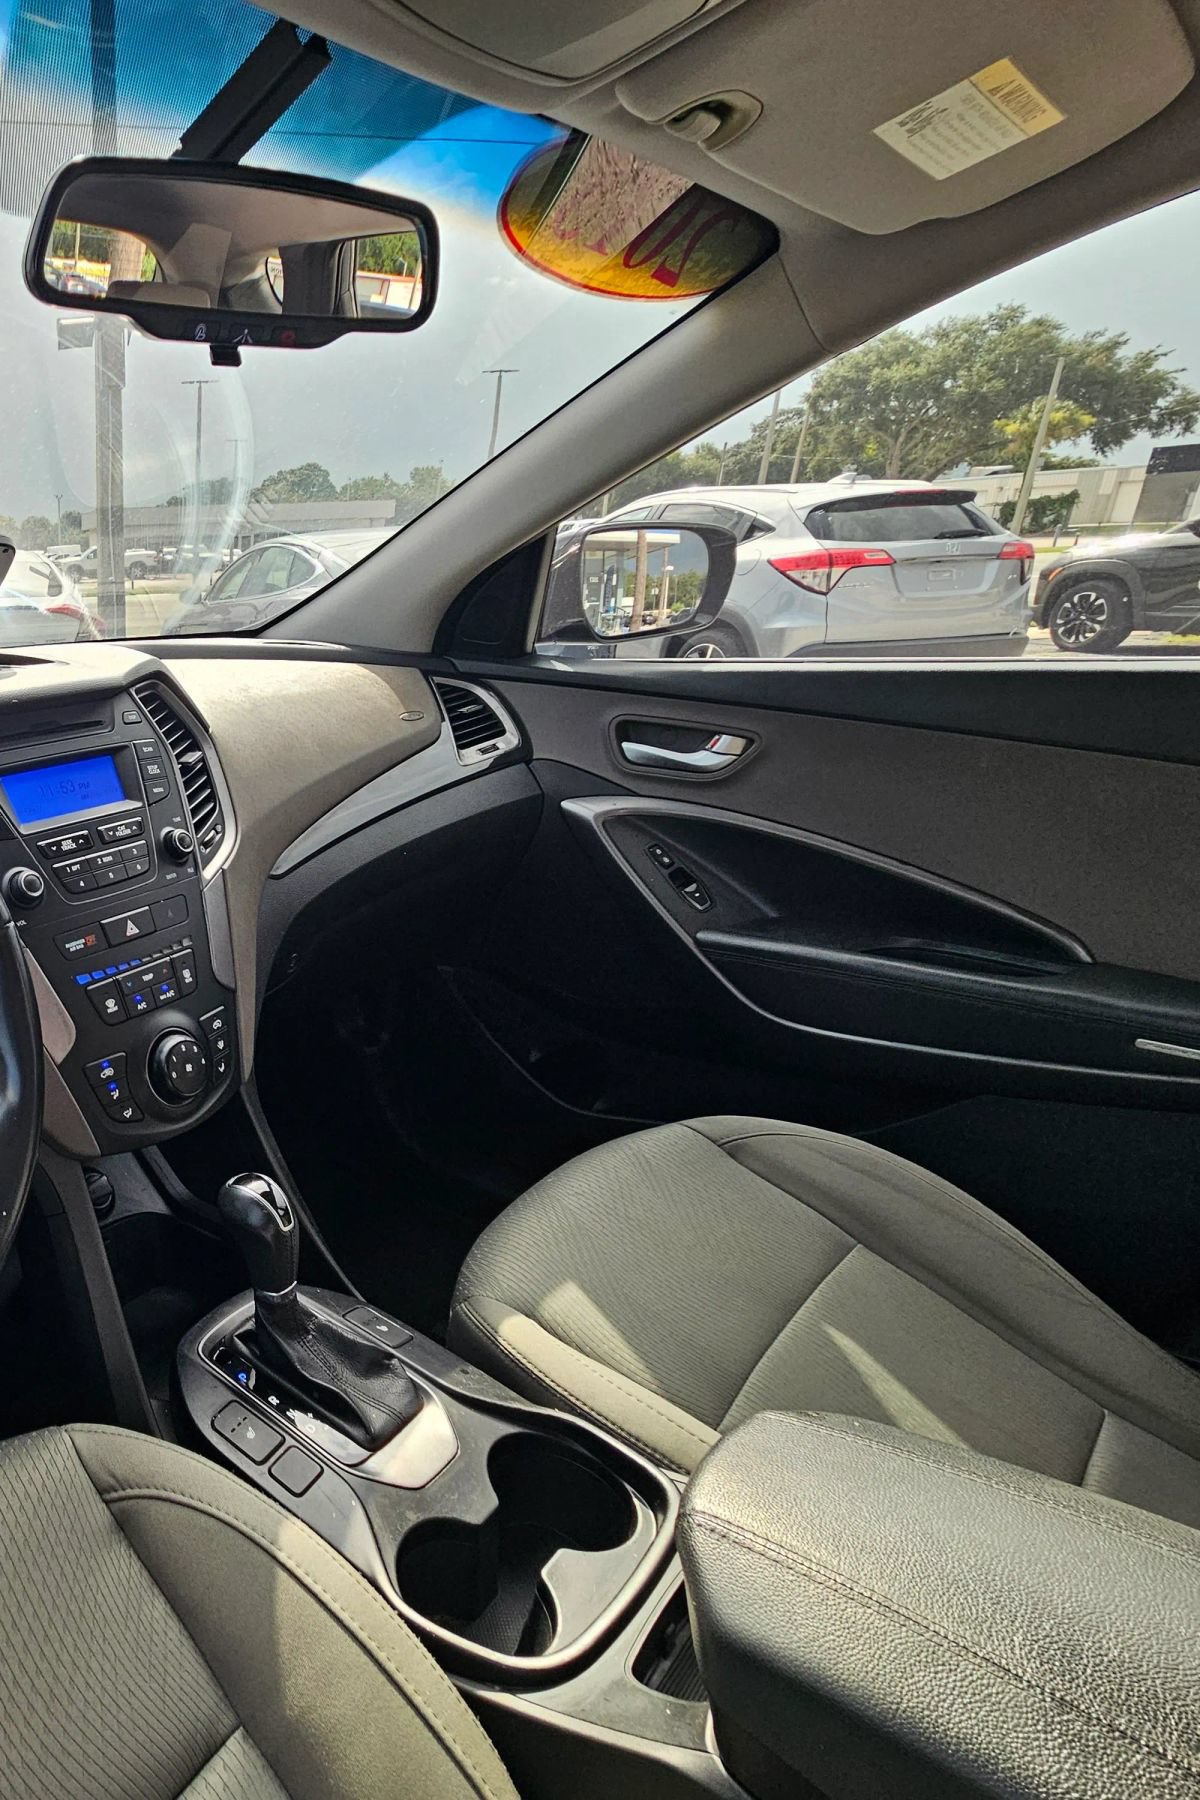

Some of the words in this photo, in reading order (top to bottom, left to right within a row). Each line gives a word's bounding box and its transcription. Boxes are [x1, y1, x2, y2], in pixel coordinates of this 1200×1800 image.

[60, 843, 78, 852] TRACK
[15, 919, 28, 927] VOL
[137, 1001, 148, 1010] A/C
[267, 1395, 280, 1406] R
